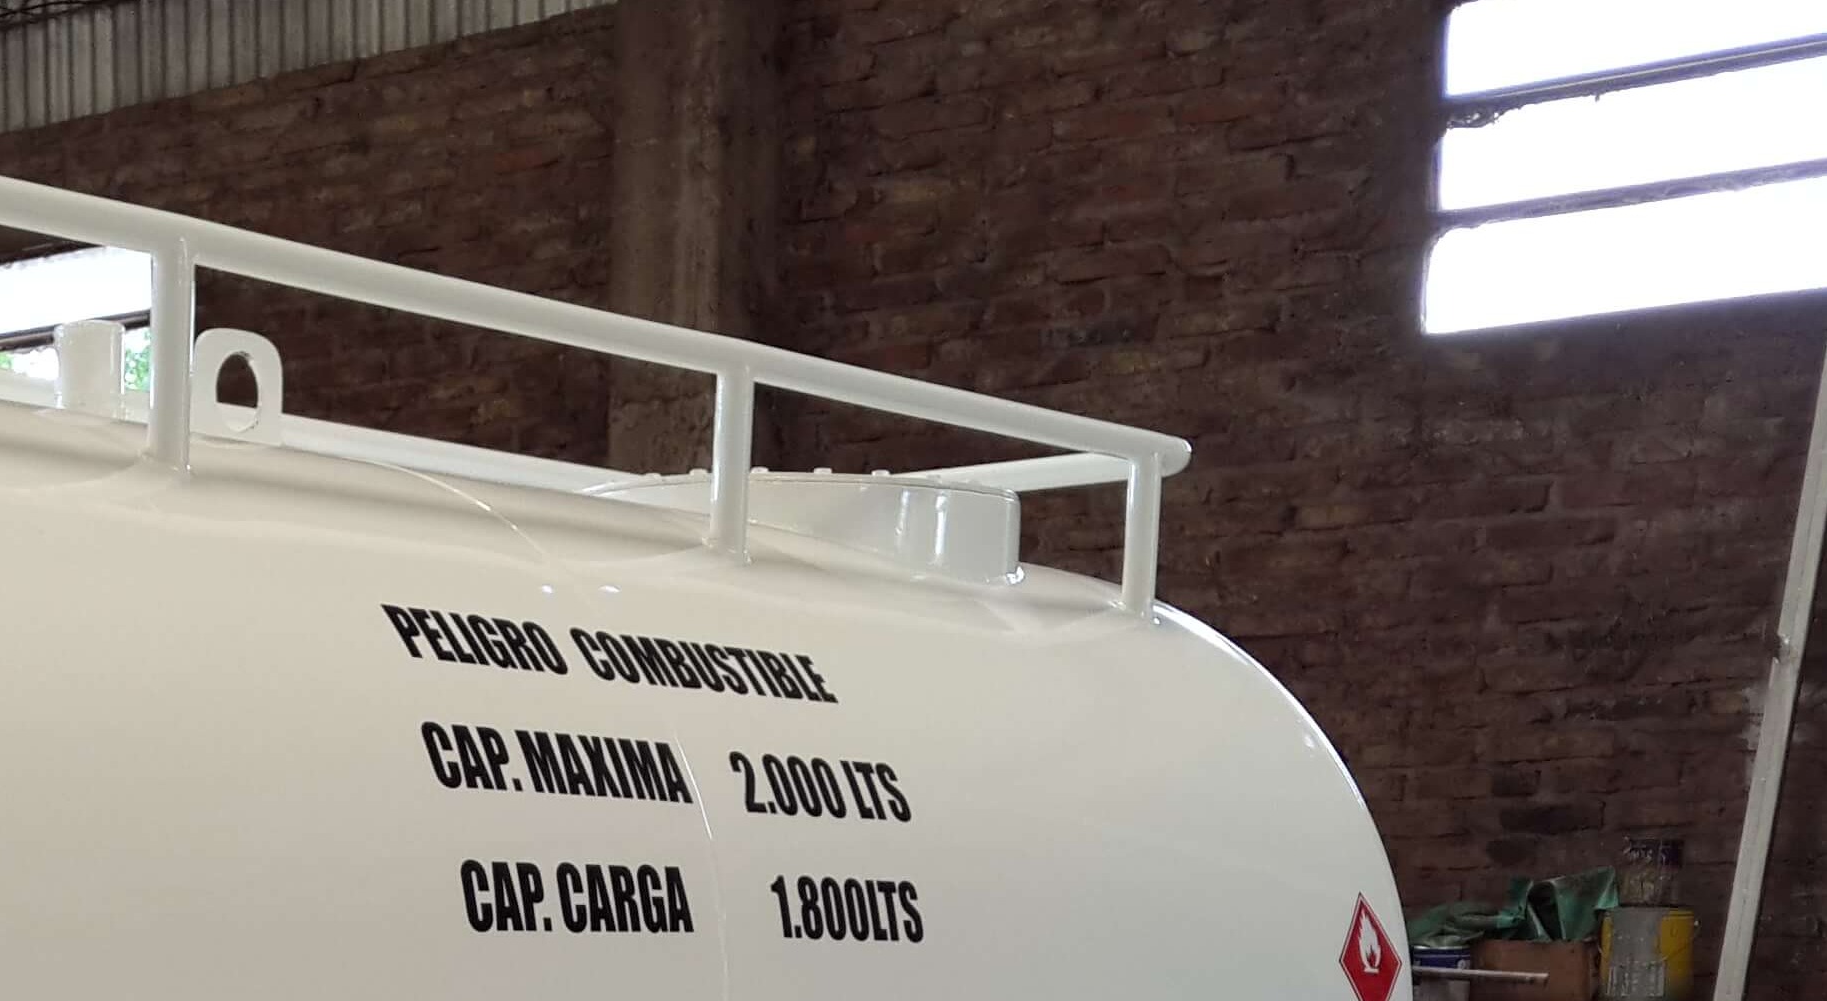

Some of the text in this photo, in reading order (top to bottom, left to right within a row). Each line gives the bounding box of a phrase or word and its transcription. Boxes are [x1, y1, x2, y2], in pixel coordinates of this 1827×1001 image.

[381, 604, 839, 704] PELIGRO COMBUSTIBLE
[420, 721, 912, 823] CAP. MAXIMA 2.000 LTS
[556, 862, 695, 934] CARGA
